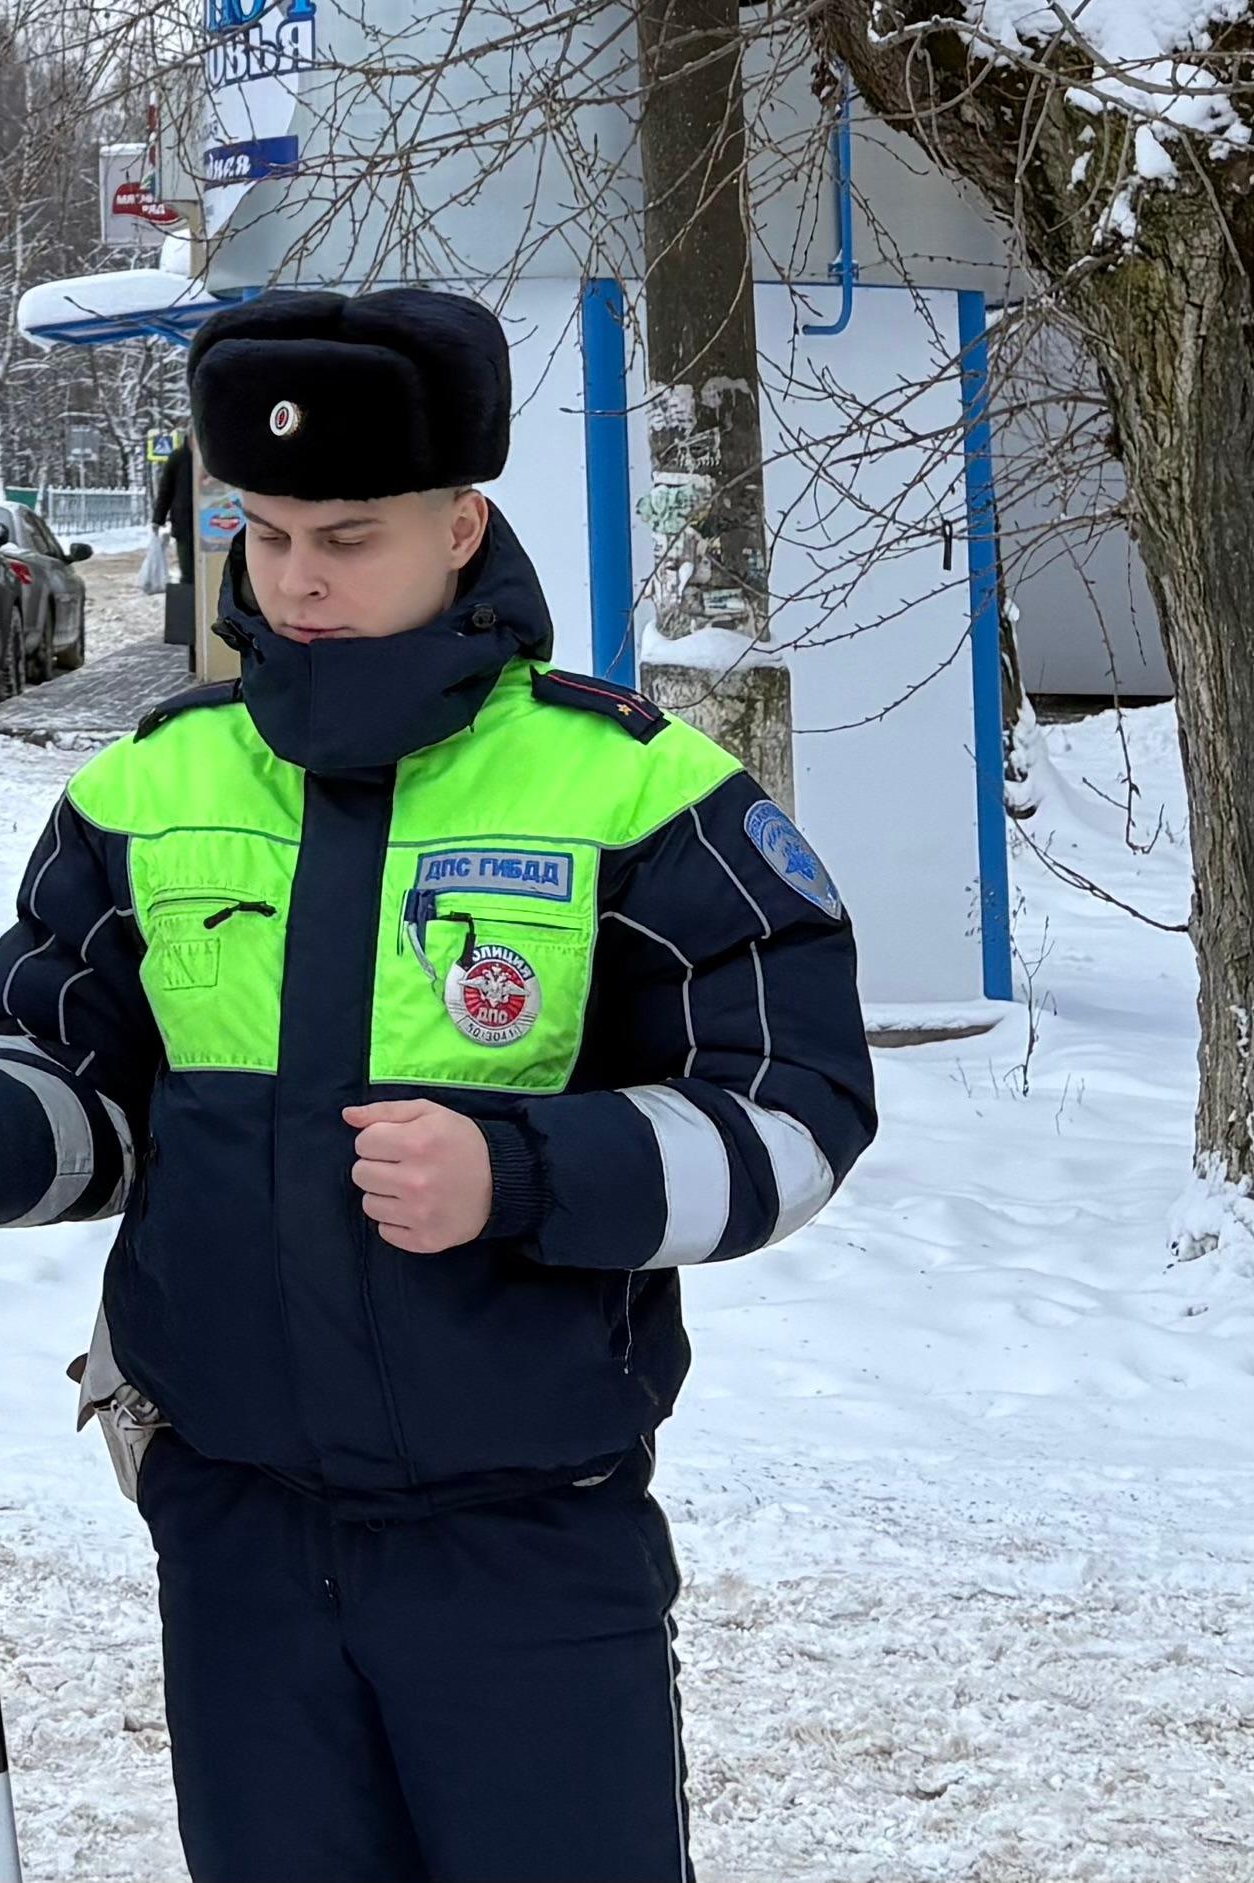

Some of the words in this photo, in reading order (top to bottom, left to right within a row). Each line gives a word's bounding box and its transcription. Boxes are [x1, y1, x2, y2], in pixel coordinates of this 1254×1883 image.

[426, 857, 471, 881] ДПС
[479, 857, 558, 886] ГИБДД
[471, 946, 533, 979] ОЛИЦИЯ
